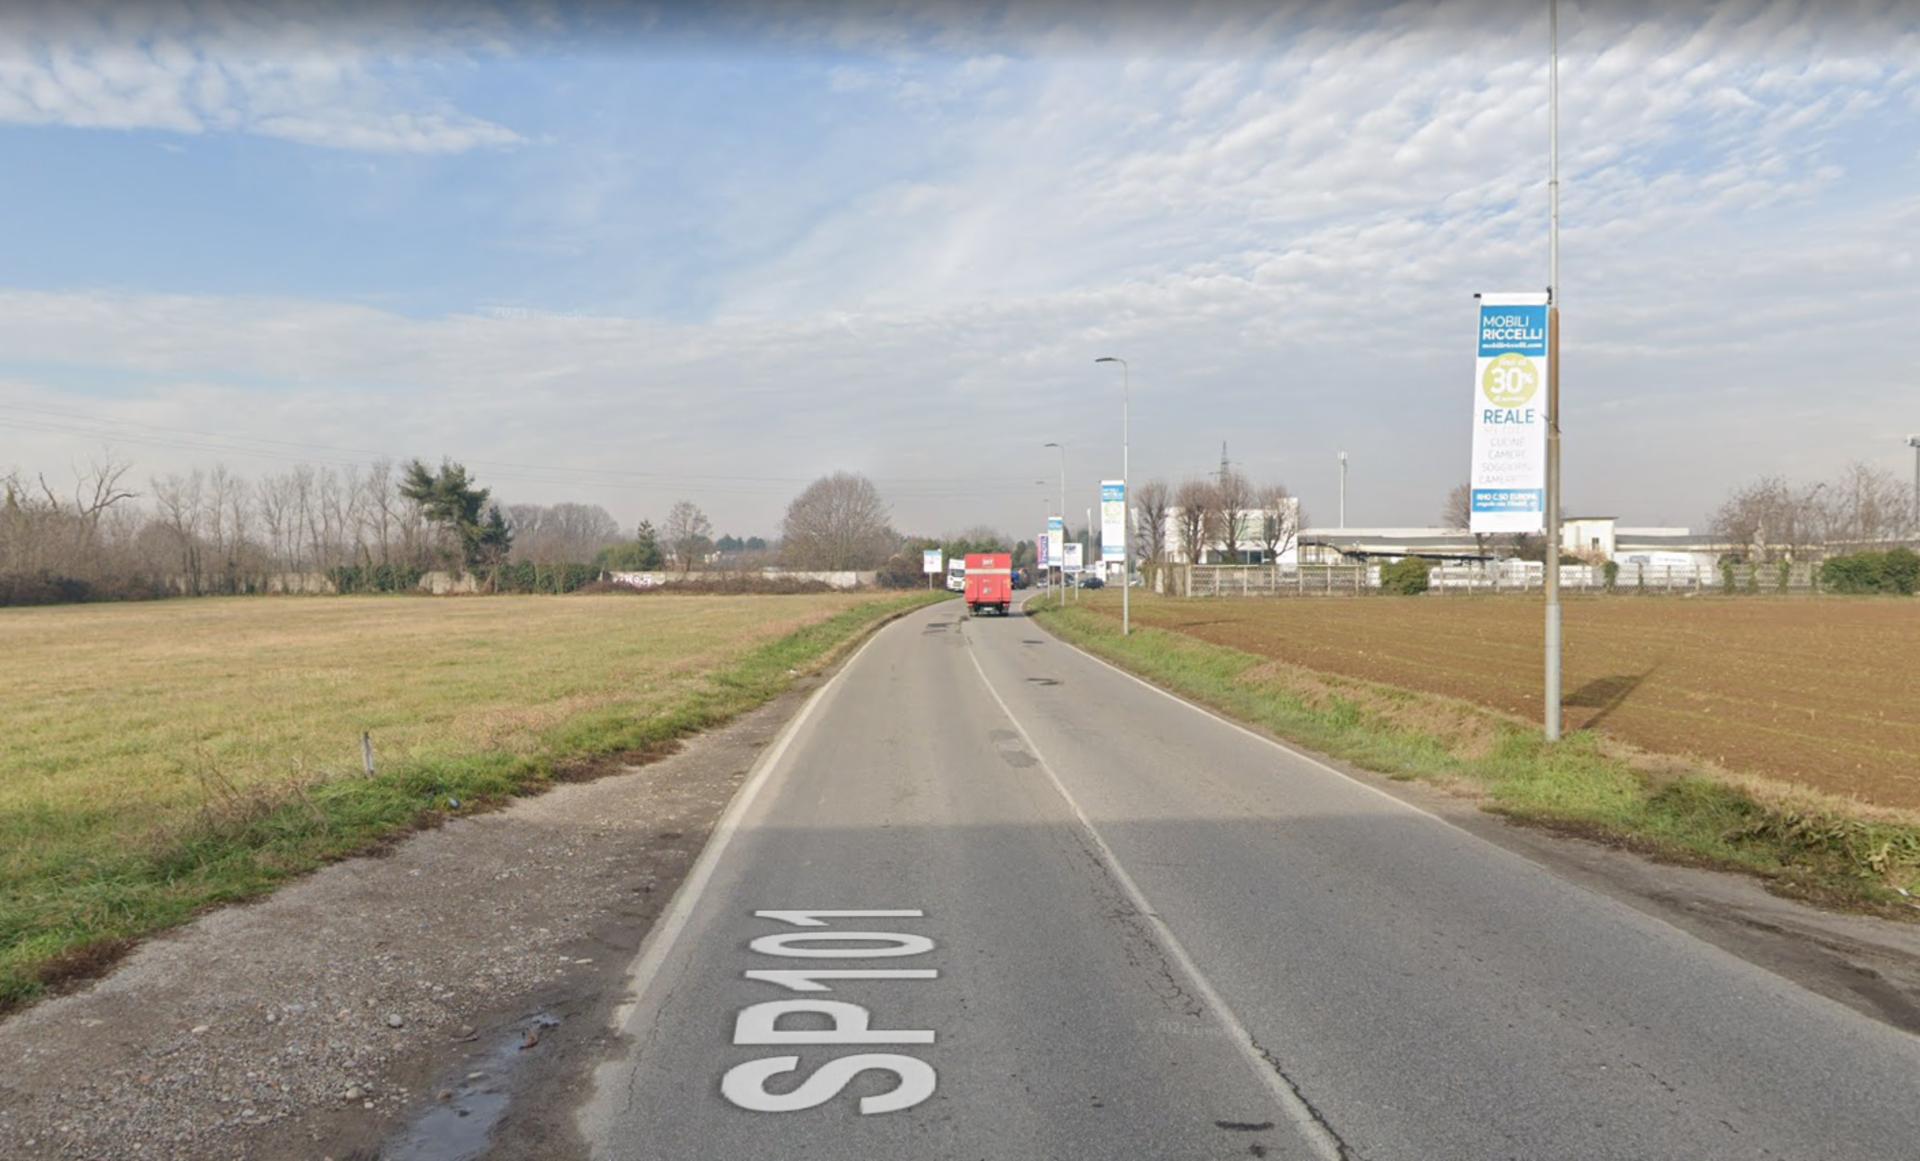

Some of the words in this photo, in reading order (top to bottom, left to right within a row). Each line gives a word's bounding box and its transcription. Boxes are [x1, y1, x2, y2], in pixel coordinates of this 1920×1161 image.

[1483, 315, 1529, 327] MOBILI
[1482, 328, 1543, 340] RICCELLI
[1483, 409, 1535, 424] REALE
